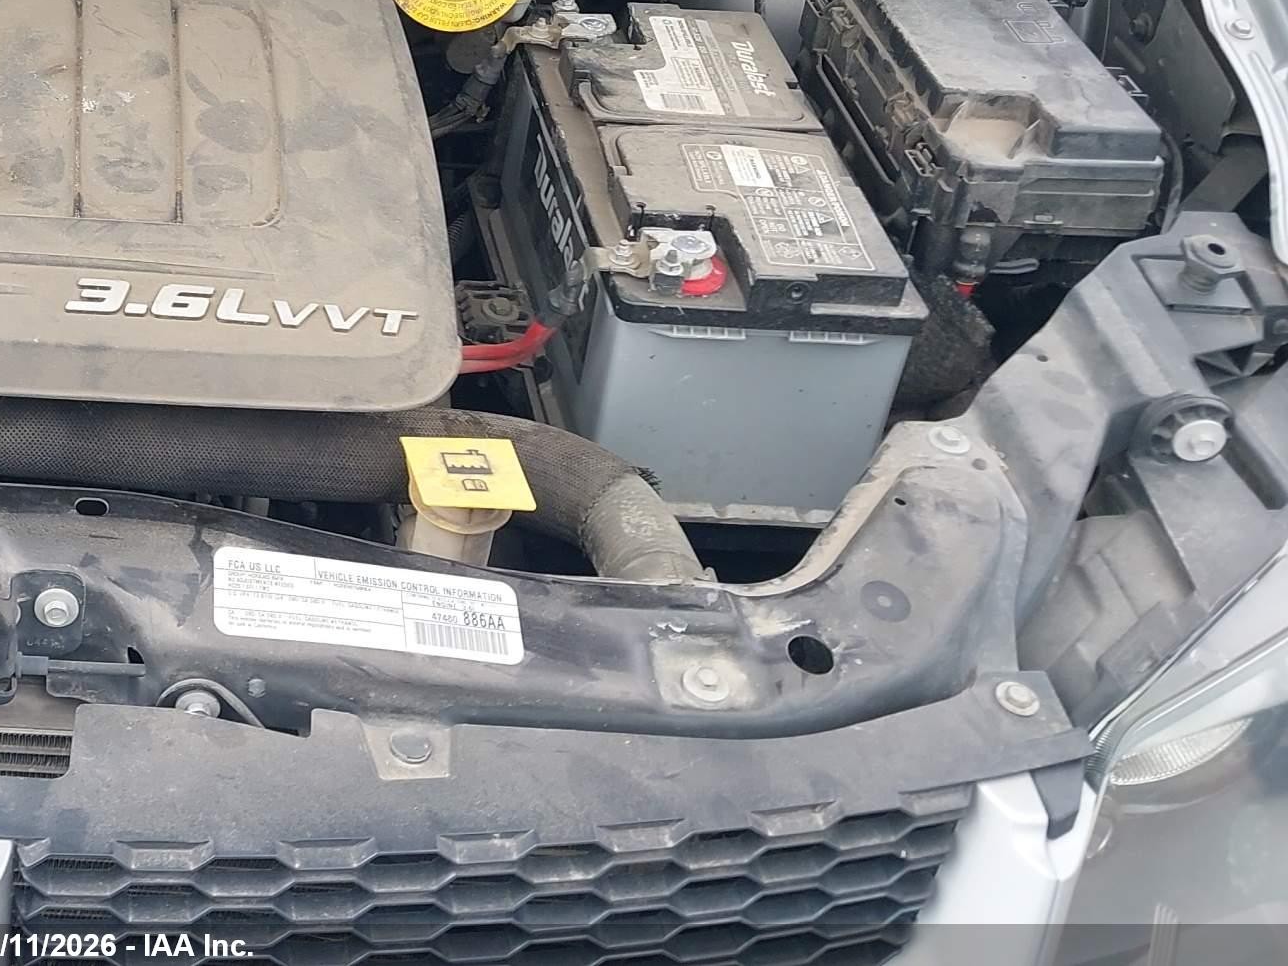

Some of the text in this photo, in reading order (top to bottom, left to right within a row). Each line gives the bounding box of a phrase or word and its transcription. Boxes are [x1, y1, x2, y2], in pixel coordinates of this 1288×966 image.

[731, 40, 777, 97] Duralast
[227, 560, 282, 575] FCA US LLC
[317, 570, 355, 586] VEHICLE
[356, 574, 398, 590] EMISSION
[399, 580, 440, 596] CONTROL
[442, 585, 503, 603] INFORMATION
[462, 610, 506, 631] 886AA
